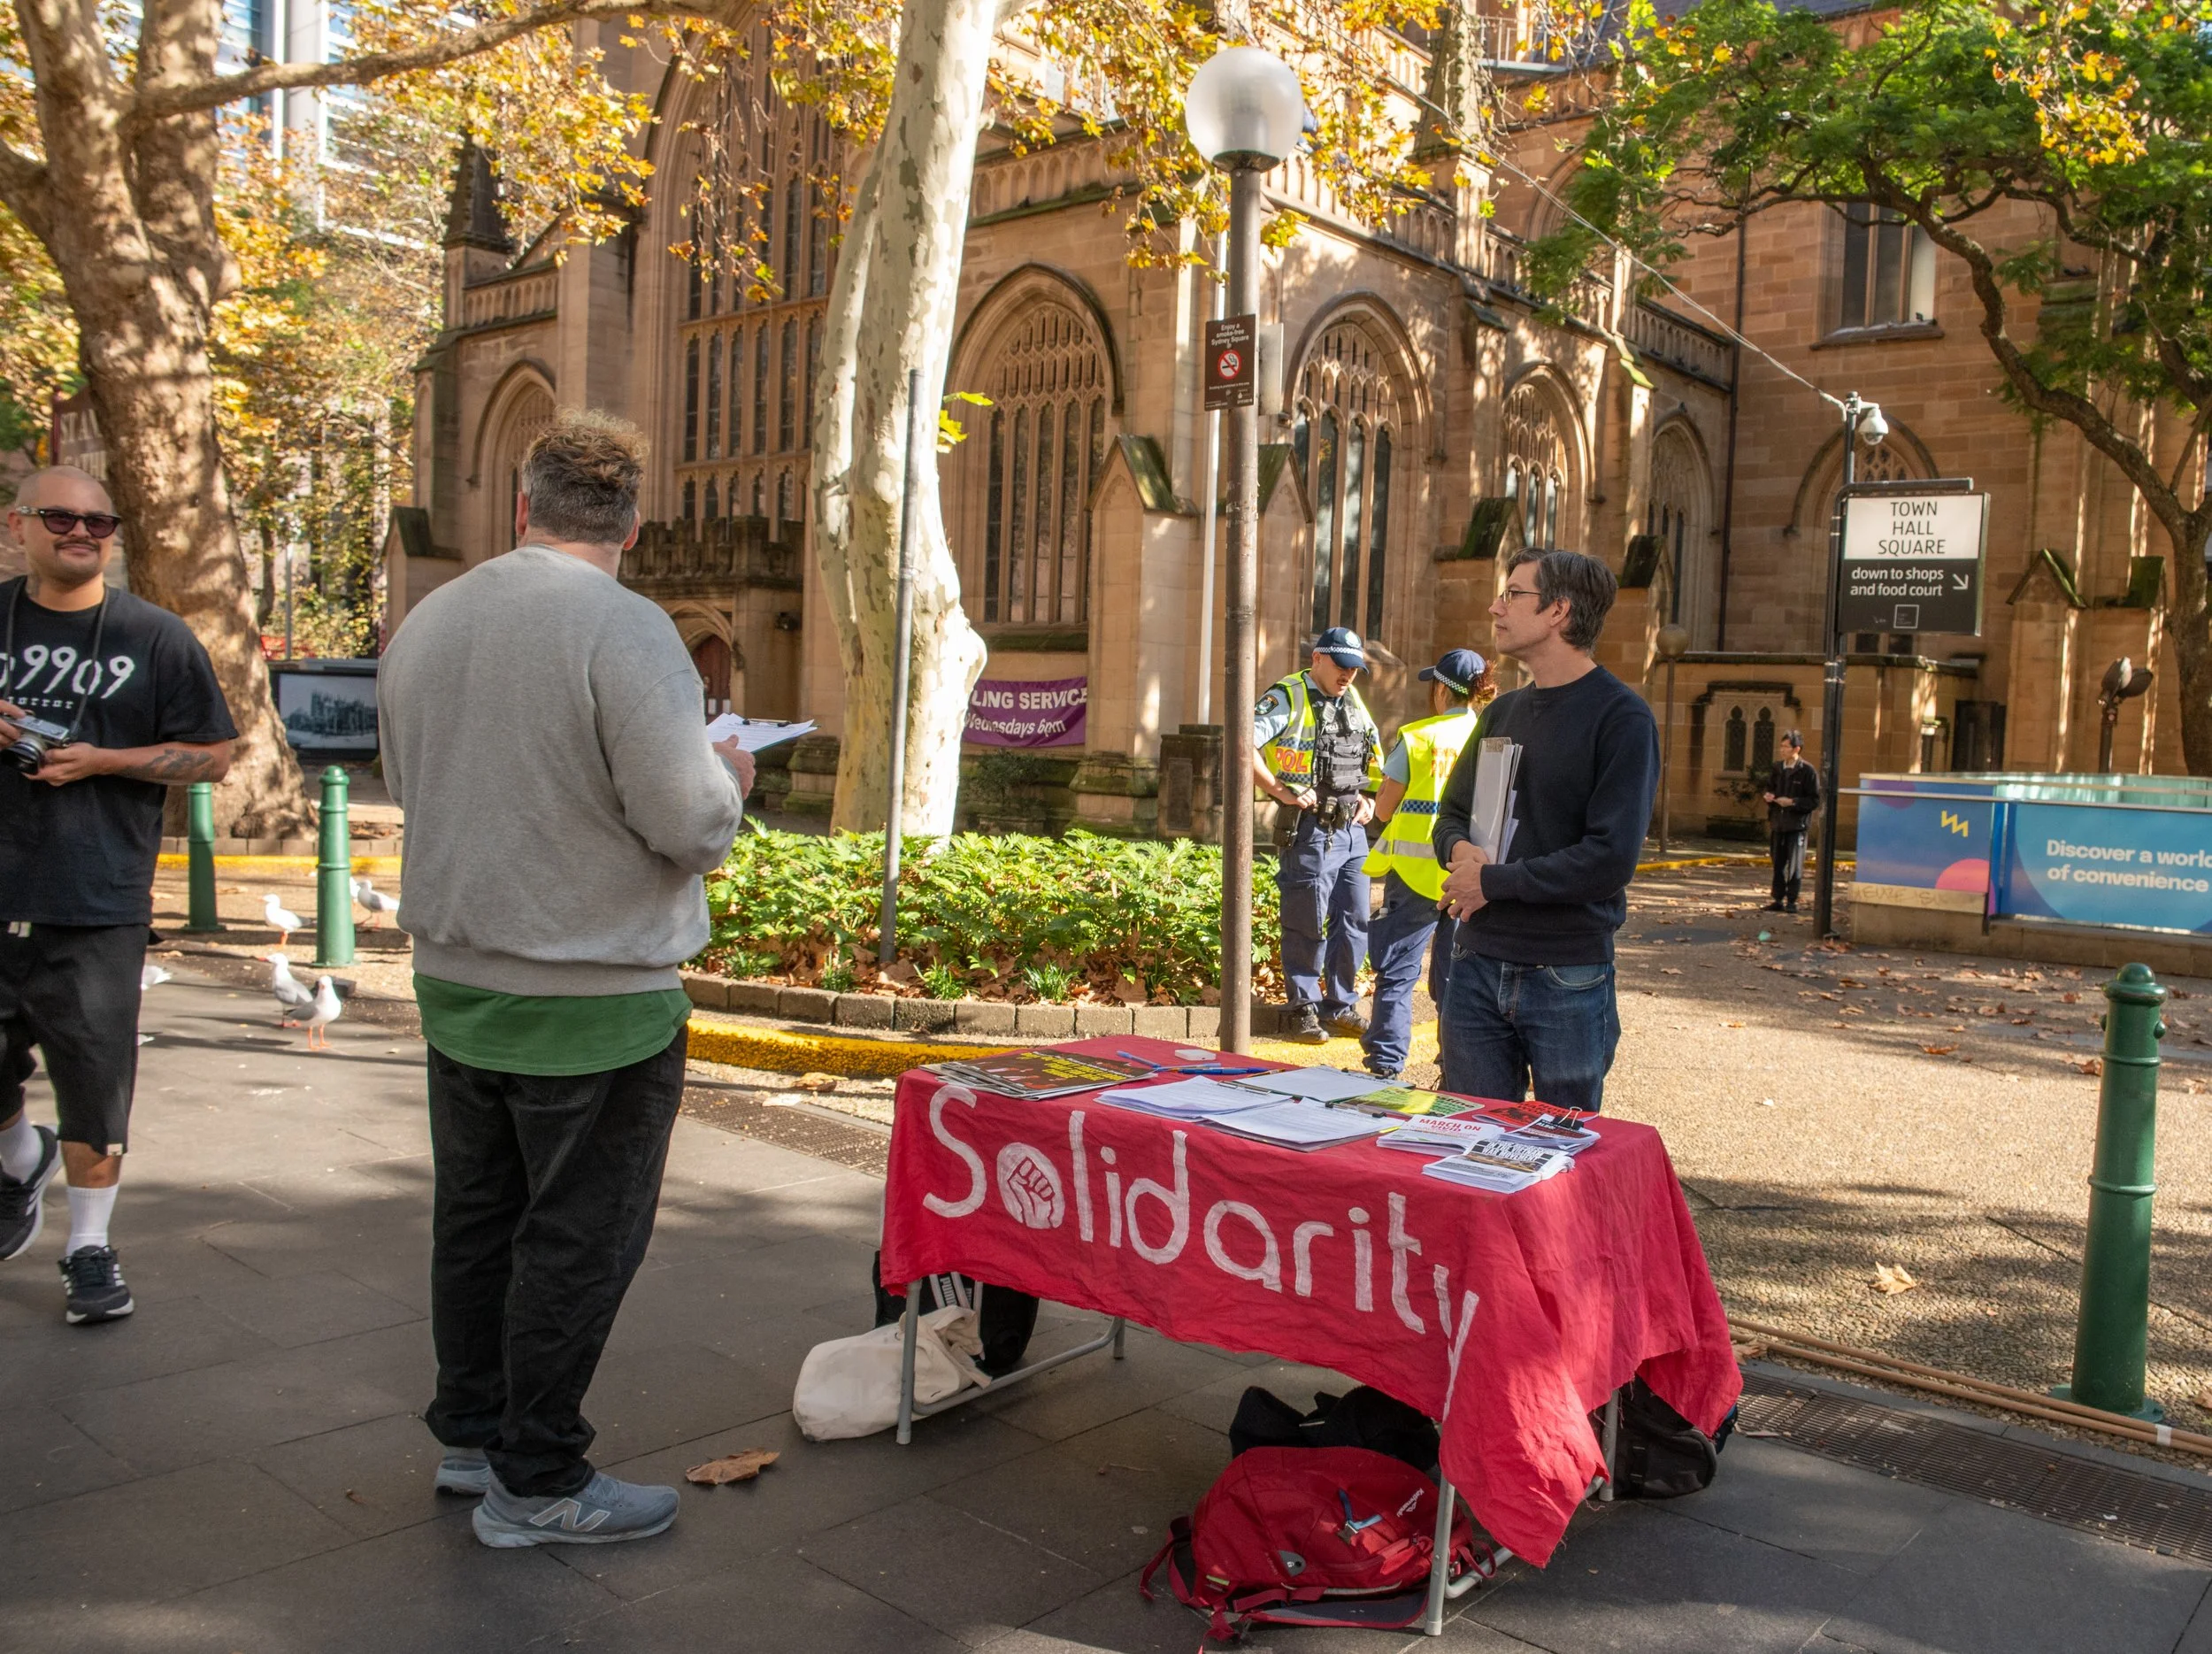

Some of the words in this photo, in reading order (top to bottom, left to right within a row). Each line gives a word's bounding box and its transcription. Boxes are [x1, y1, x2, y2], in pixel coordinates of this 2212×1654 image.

[1216, 328, 1245, 338] smoke-free
[1220, 323, 1236, 332] Enjoy
[1231, 335, 1249, 343] Square
[1890, 501, 1938, 517] TOWN
[1892, 520, 1934, 535] HALL
[1878, 539, 1947, 557] SQUARE
[1851, 566, 1887, 580] down
[1890, 567, 1903, 580] to
[1905, 566, 1945, 582] shops
[1850, 583, 1876, 596] and
[1878, 582, 1907, 596] food
[1909, 584, 1943, 596] court
[1037, 718, 1067, 737] 6pm
[2046, 839, 2136, 863] Discover
[2139, 849, 2154, 864] a
[2047, 864, 2071, 881] of
[2073, 870, 2209, 893] convenience
[1419, 1118, 1462, 1129] MARCH
